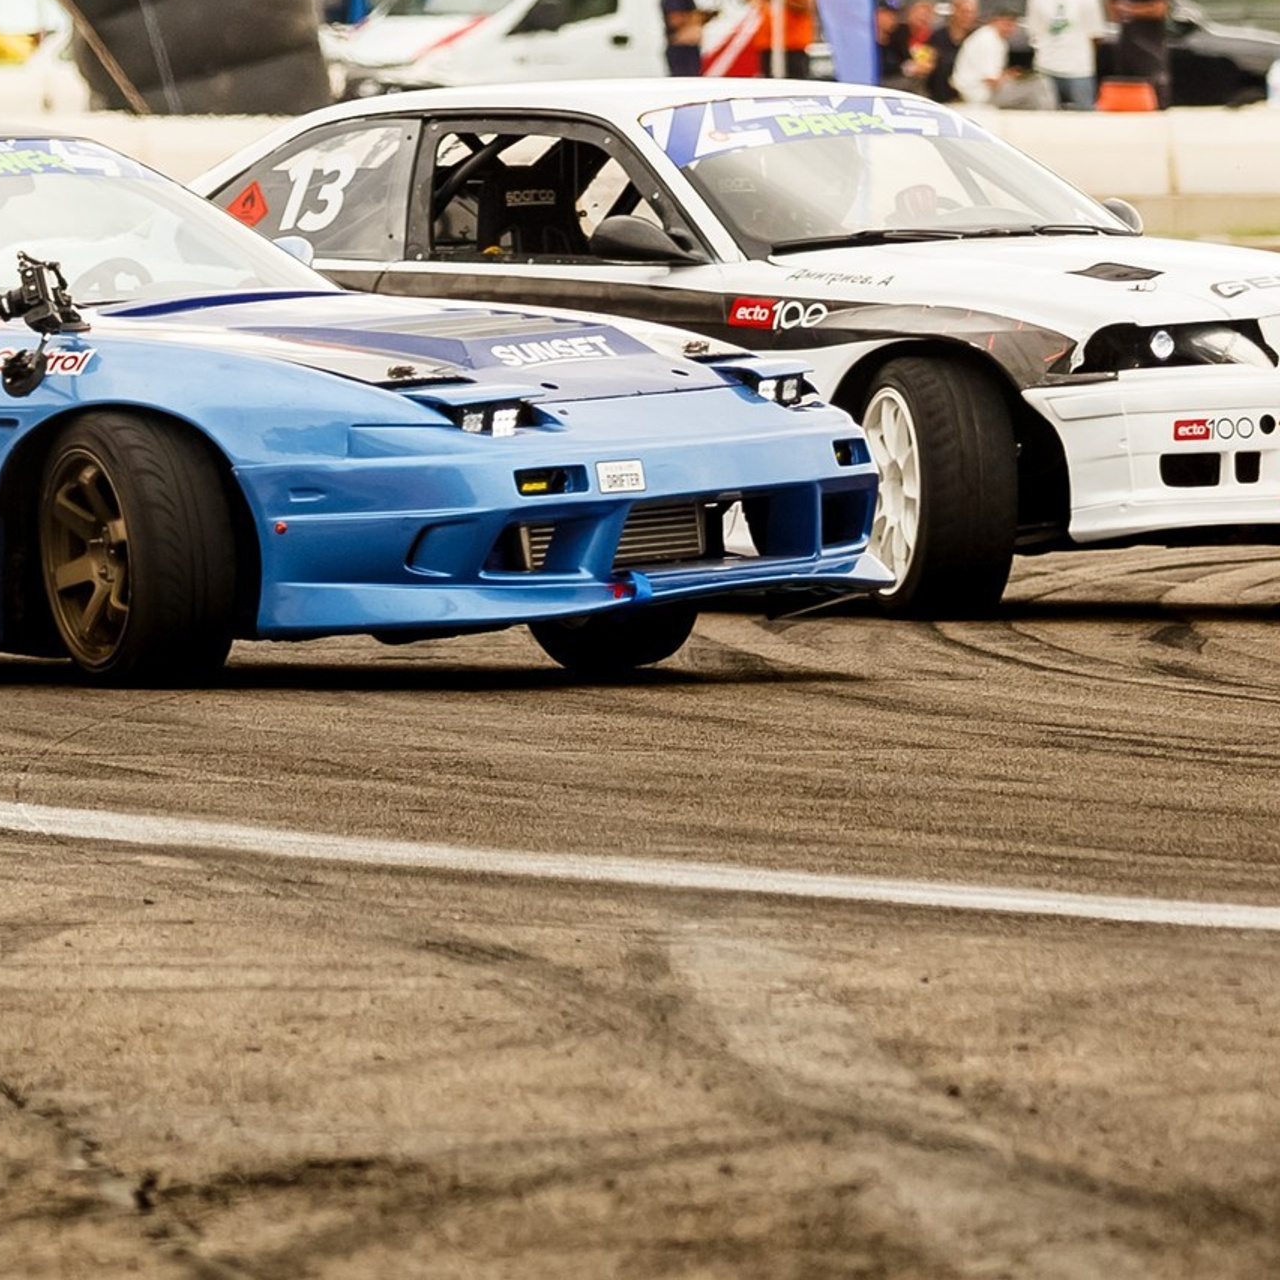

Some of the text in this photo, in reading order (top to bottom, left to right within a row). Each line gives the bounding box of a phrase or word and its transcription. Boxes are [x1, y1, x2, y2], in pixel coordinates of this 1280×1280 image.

[774, 110, 895, 137] DRIFT
[279, 153, 357, 232] 13
[1209, 276, 1280, 300] GE
[490, 335, 618, 367] SUNSET
